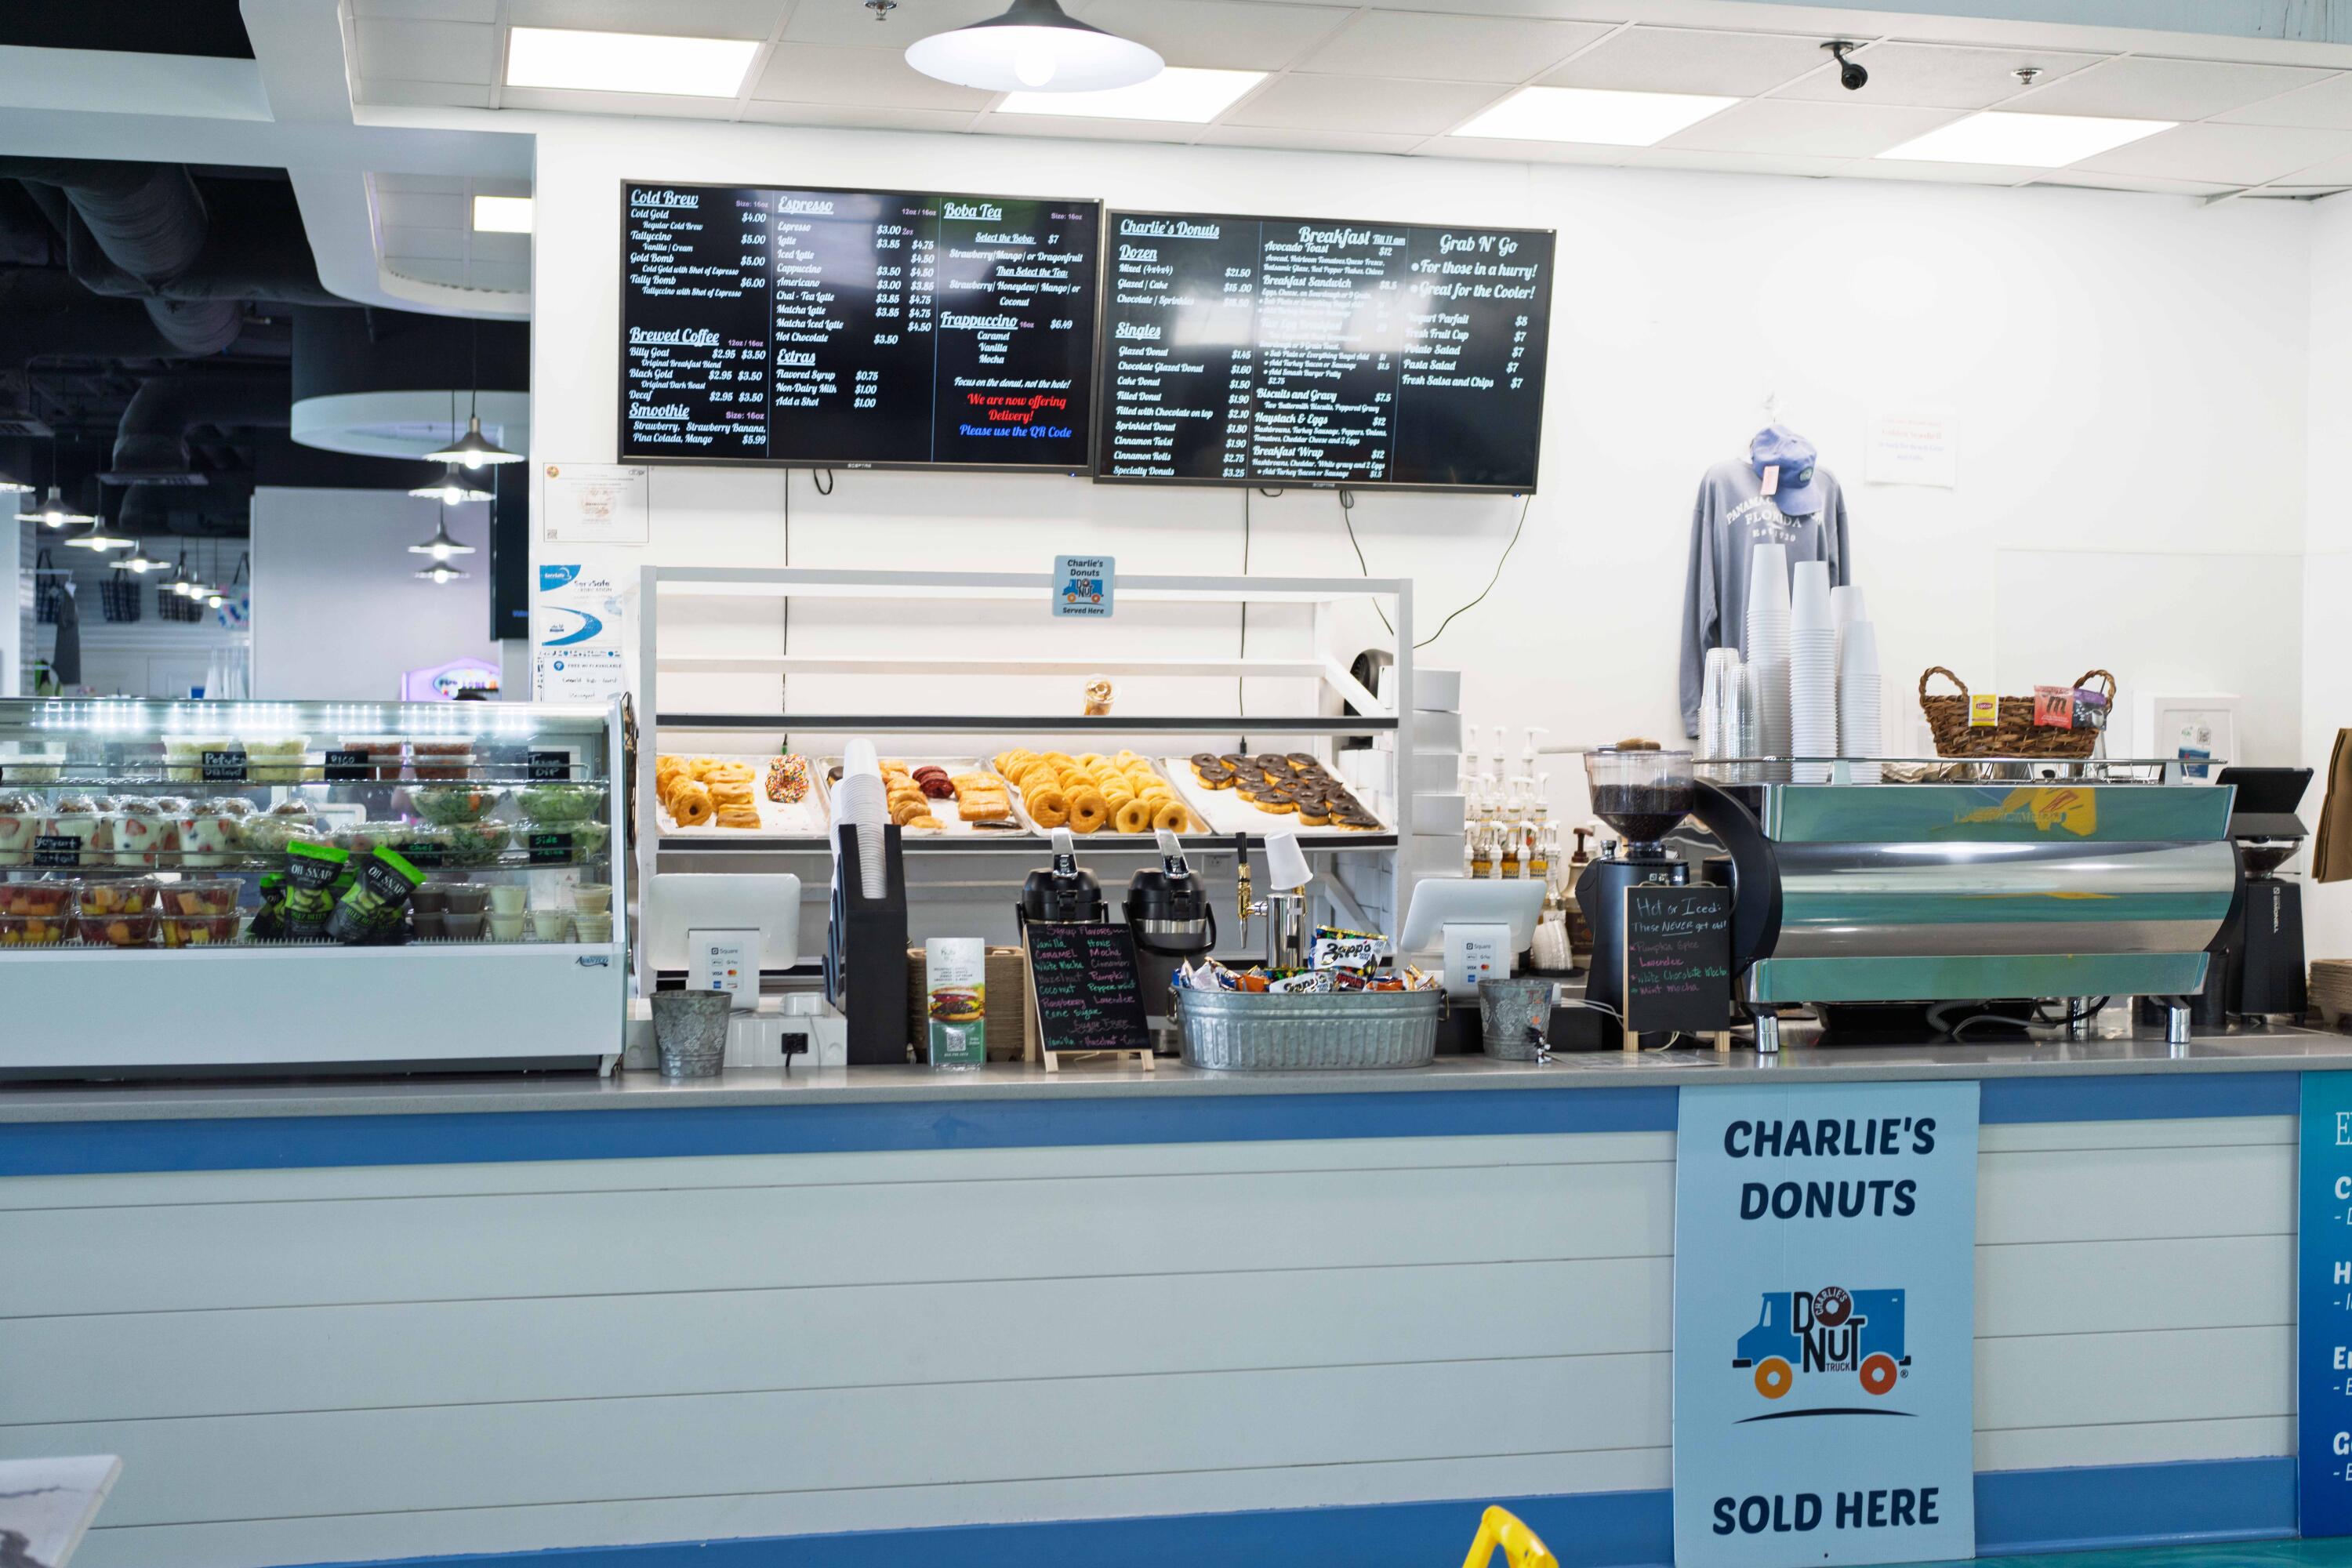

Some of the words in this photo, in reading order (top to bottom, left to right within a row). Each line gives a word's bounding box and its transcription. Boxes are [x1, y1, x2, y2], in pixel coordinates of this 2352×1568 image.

[631, 189, 659, 205] Cold
[663, 190, 699, 207] Brew
[778, 196, 833, 215] Espresso
[944, 202, 977, 218] Boba
[979, 203, 1002, 218] Tea
[630, 209, 649, 219] Cold
[651, 210, 669, 220] Gold
[742, 212, 767, 223] $4.00
[643, 221, 669, 230] Regular
[670, 221, 685, 230] Cold
[1120, 219, 1174, 234] Charlie's
[1176, 221, 1220, 237] Donuts
[630, 230, 672, 241] Tallyccino
[742, 234, 766, 245] $5.00
[1298, 226, 1371, 249] Breakfast
[1265, 241, 1303, 252] Avocado
[1305, 242, 1329, 253] Toast
[1378, 247, 1392, 256] $12
[1440, 234, 1475, 254] Grab
[1479, 236, 1496, 252] N'
[1498, 237, 1518, 256] Go
[630, 253, 649, 263] Gold
[651, 253, 674, 263] Bomb
[1120, 245, 1157, 260] Dozen
[1420, 260, 1440, 273] For
[1442, 261, 1472, 274] those
[1474, 263, 1486, 275] in
[1488, 267, 1497, 276] a
[1498, 263, 1538, 281] hurry!
[630, 275, 650, 285] Tally
[653, 275, 676, 285] Bomb
[740, 278, 765, 289] $6.00
[777, 277, 820, 287] Americano
[1420, 281, 1452, 297] Great
[1451, 284, 1472, 299] for
[1473, 285, 1491, 297] the
[1494, 284, 1536, 299] Cooler!
[1000, 296, 1029, 307] Coconut
[941, 311, 1018, 330] Frappuccino
[1050, 319, 1073, 329] $6.49
[630, 326, 679, 343] Brewed
[682, 328, 720, 346] Coffee
[978, 331, 1010, 340] Caramel
[1116, 321, 1161, 339] Singles
[776, 332, 789, 341] Hot
[791, 332, 829, 343] Chocolate
[873, 335, 898, 344] $3.50
[630, 347, 649, 358] Billy
[651, 348, 670, 358] Goat
[777, 348, 815, 363] Extras
[1119, 346, 1144, 357] Glazed
[1145, 347, 1168, 356] Donut
[641, 359, 668, 368] Original
[670, 359, 701, 369] Breakfast
[1403, 359, 1428, 370] Pasta
[1429, 360, 1457, 371] Salad
[630, 369, 652, 378] Black
[654, 370, 673, 379] Gold
[776, 369, 810, 379] Flavored
[811, 370, 836, 381] Syrup
[855, 370, 878, 381] $0.75
[1117, 376, 1137, 386] Cake
[1138, 377, 1160, 387] Donut
[1402, 375, 1425, 385] Fresh
[1427, 376, 1451, 386] Salsa
[1452, 377, 1469, 387] and
[1471, 377, 1494, 390] Chips
[1511, 378, 1523, 390] $7
[629, 390, 653, 401] Decaf
[776, 397, 793, 406] Add
[800, 397, 819, 406] Shot
[967, 394, 984, 405] We
[986, 396, 1003, 405] are
[1005, 397, 1026, 406] now
[1028, 394, 1066, 410] offering
[1256, 388, 1290, 399] Biscuits
[1291, 390, 1308, 399] and
[1311, 390, 1337, 402] Gravy
[1375, 394, 1392, 402] $7.5
[629, 402, 690, 418] Smoothie
[989, 409, 1034, 424] Delivery!
[960, 424, 991, 436] Please
[1012, 426, 1027, 437] the
[1029, 426, 1046, 438] QR
[1048, 426, 1072, 438] Code
[633, 433, 652, 442] Pina
[654, 434, 683, 444] Colada,
[685, 434, 713, 445] Mango
[742, 434, 766, 445] $5.99
[1114, 451, 1152, 461] Cinnamon
[1152, 452, 1171, 461] Rolls
[1224, 454, 1244, 463] $2.75
[1253, 446, 1295, 459] Breakfast
[1298, 447, 1323, 459] Wrap
[1113, 466, 1148, 477] Specialty
[1149, 466, 1174, 476] Donuts
[1223, 468, 1245, 478] $3.25
[1745, 510, 1802, 528] FLORIDA
[291, 864, 303, 875] OH
[1637, 897, 1662, 916] Hot
[1632, 922, 1660, 932] These
[1662, 921, 1693, 932] NEVER
[1695, 923, 1709, 932] get
[1724, 1117, 1936, 1158] CHARLIE'S
[1740, 1179, 1917, 1220] DONUTS
[1814, 1287, 1848, 1316] CHARLIE'S
[1826, 1363, 1850, 1372] TRUCK
[1712, 1493, 1823, 1536] SOLD
[1835, 1487, 1940, 1530] HERE
